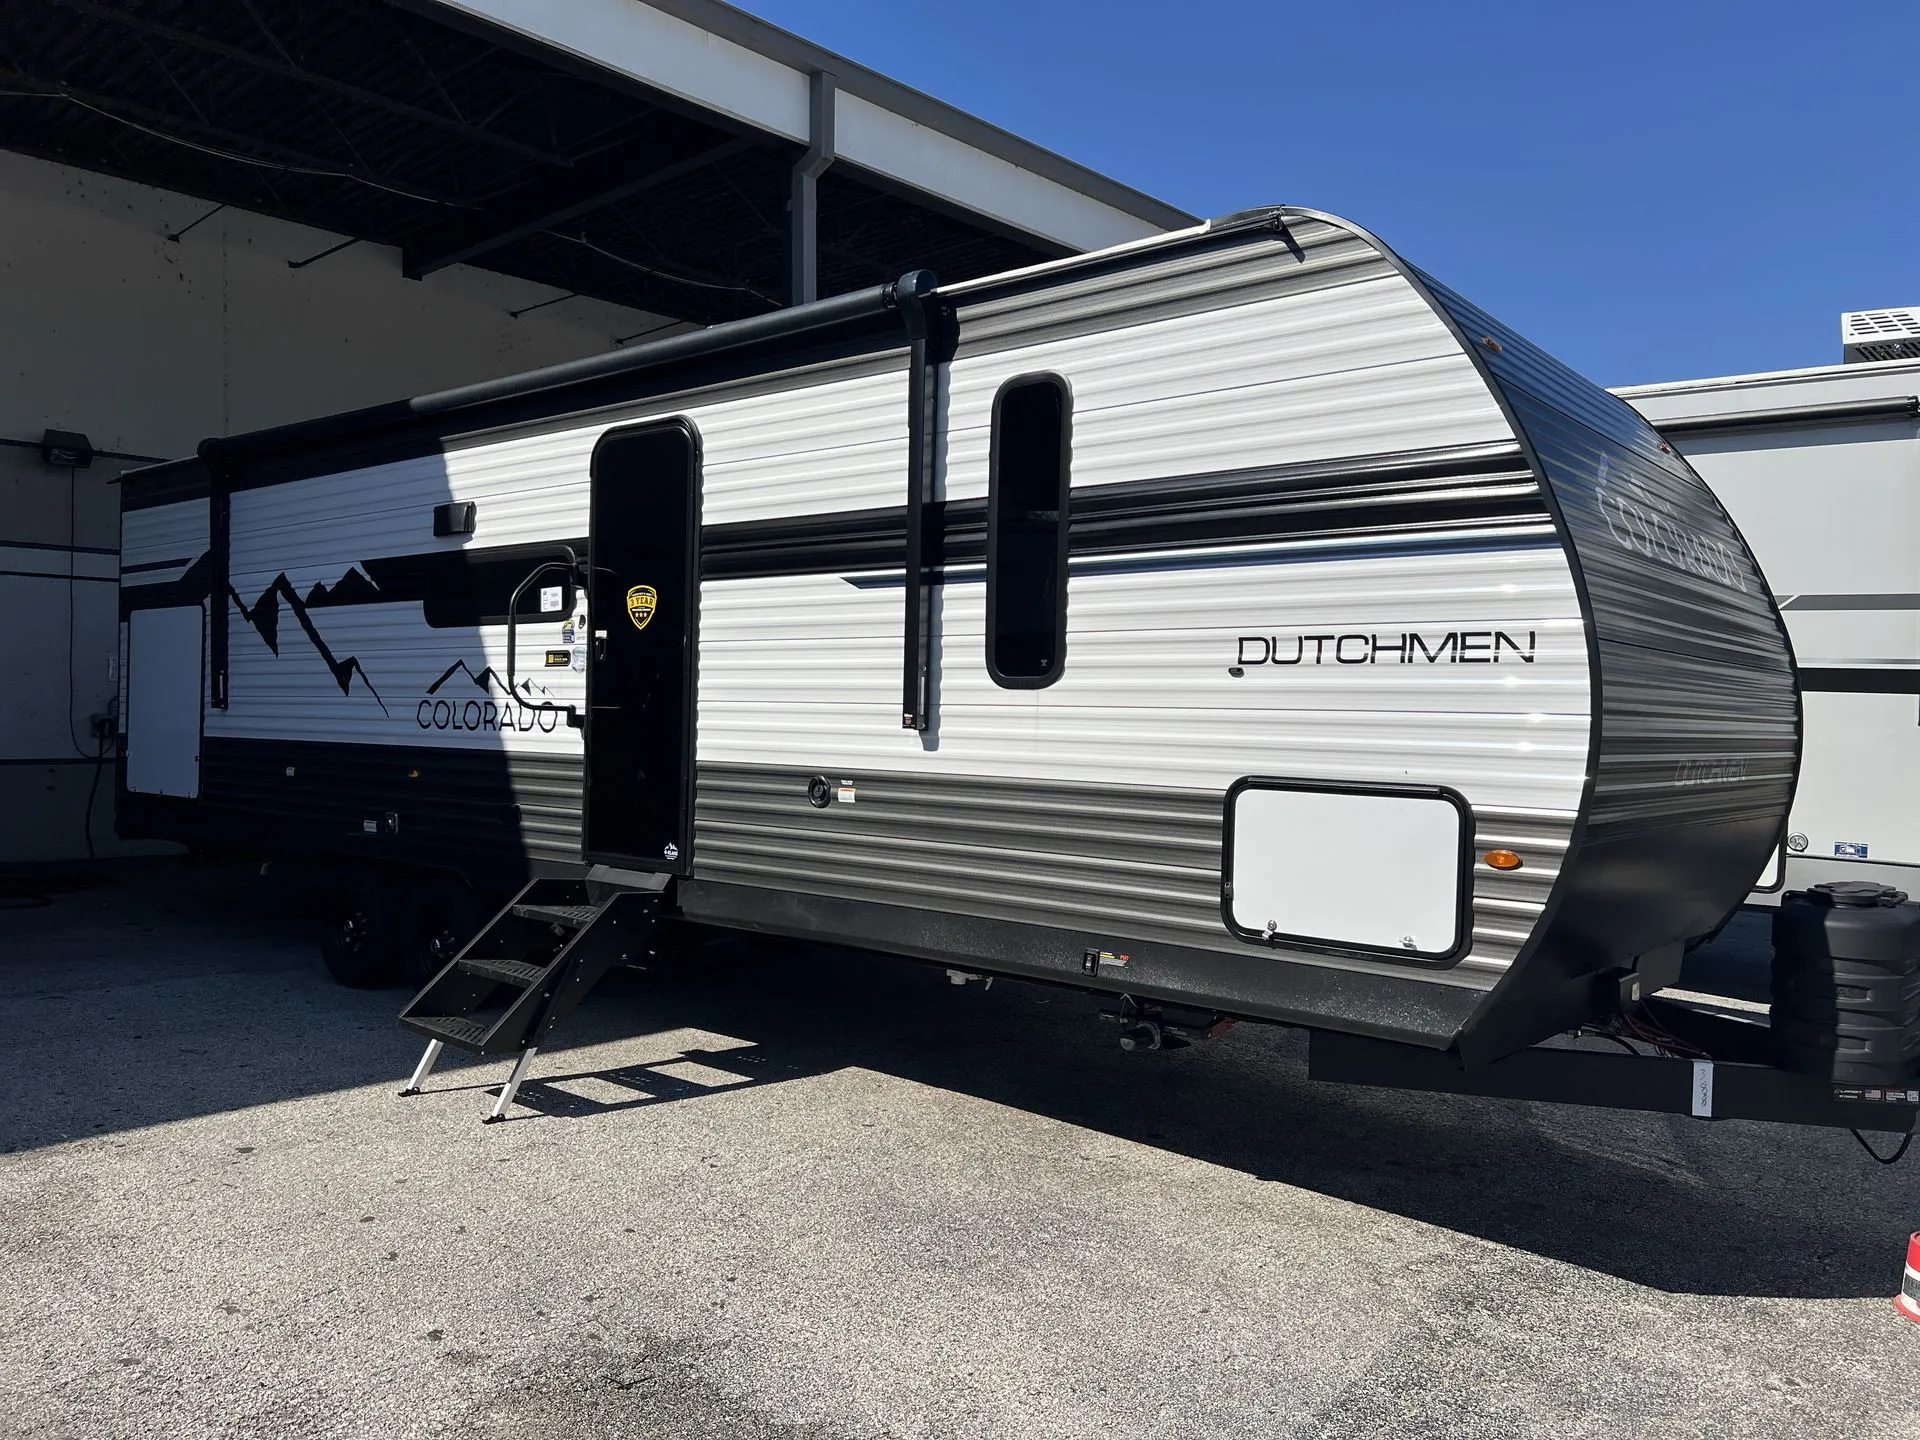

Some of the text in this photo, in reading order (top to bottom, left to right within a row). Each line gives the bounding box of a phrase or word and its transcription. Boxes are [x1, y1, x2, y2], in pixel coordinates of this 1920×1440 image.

[1594, 486, 1748, 593] COLORADO
[636, 596, 654, 606] YEAR
[1238, 631, 1536, 665] DUTCHMEN
[416, 699, 558, 734] COLORADO
